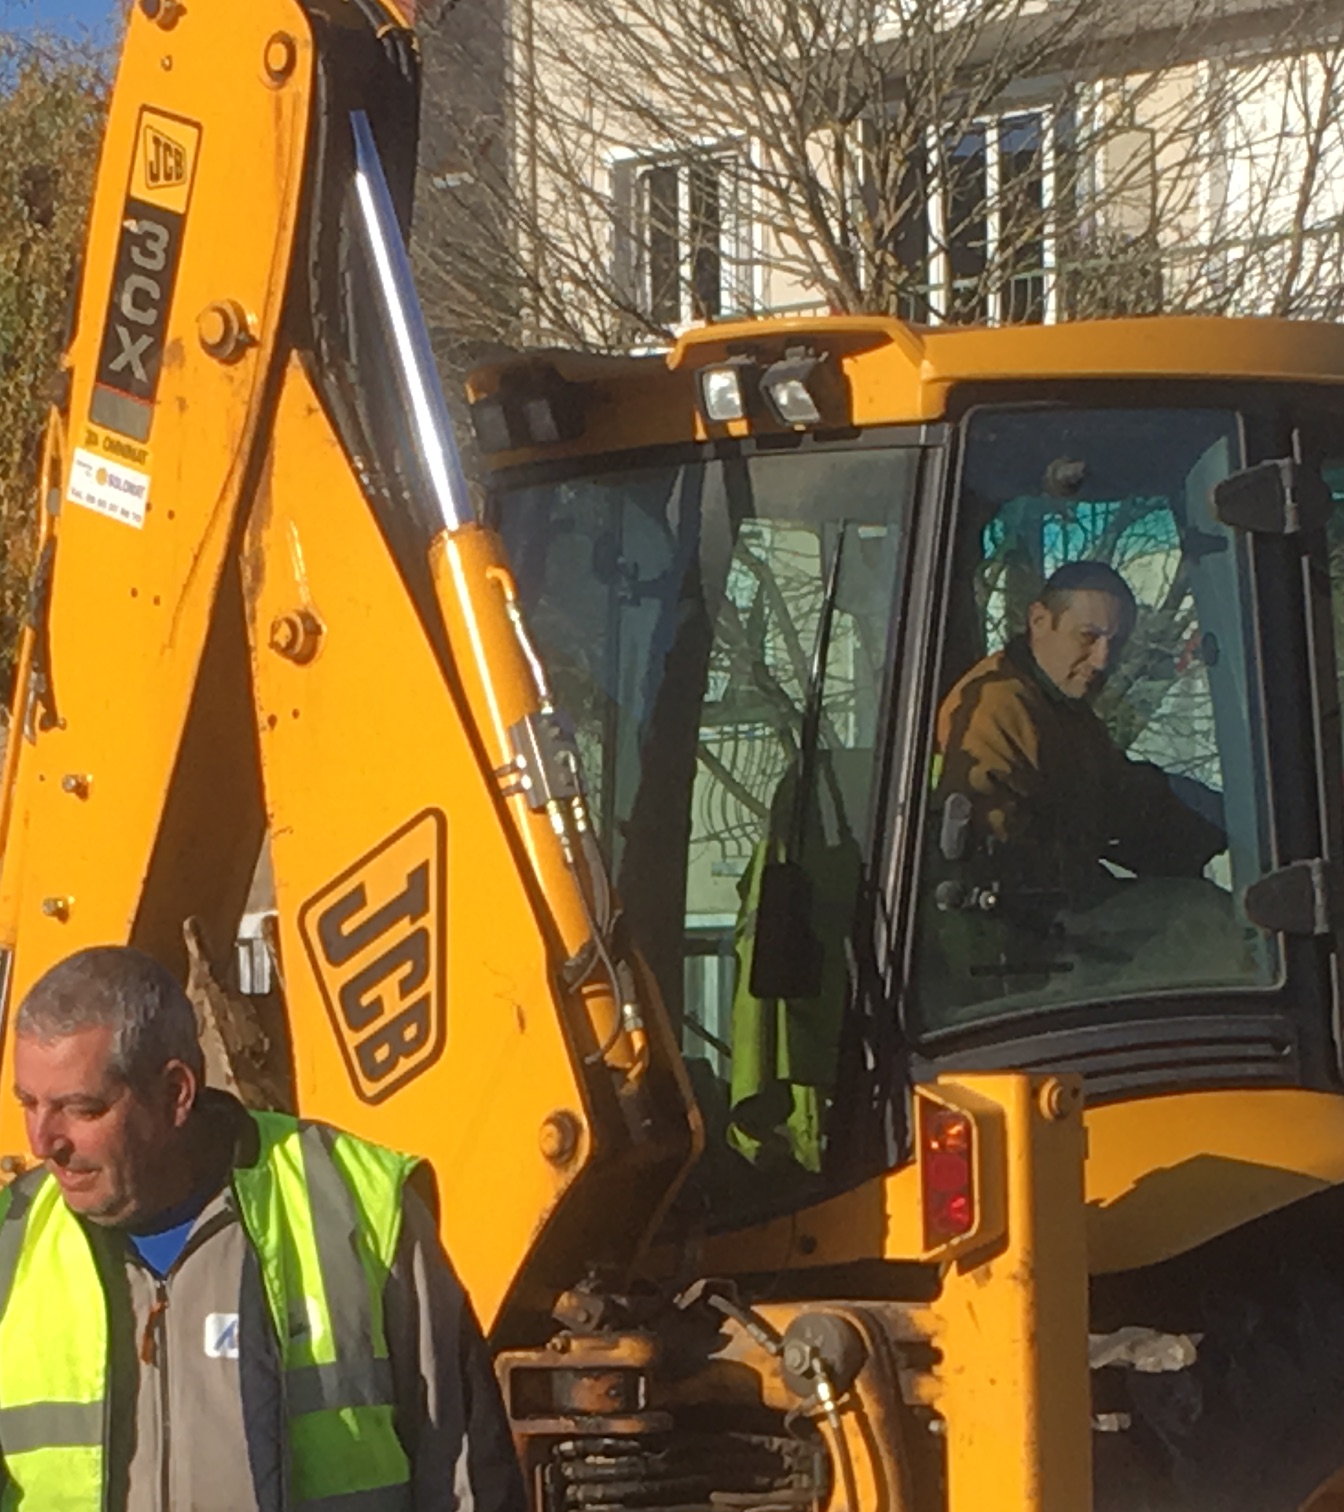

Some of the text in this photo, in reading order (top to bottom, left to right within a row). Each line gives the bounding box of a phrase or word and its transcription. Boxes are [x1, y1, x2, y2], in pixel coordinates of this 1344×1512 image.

[148, 135, 184, 183] JCB
[109, 219, 170, 383] 3CX
[317, 859, 430, 1084] JCB
